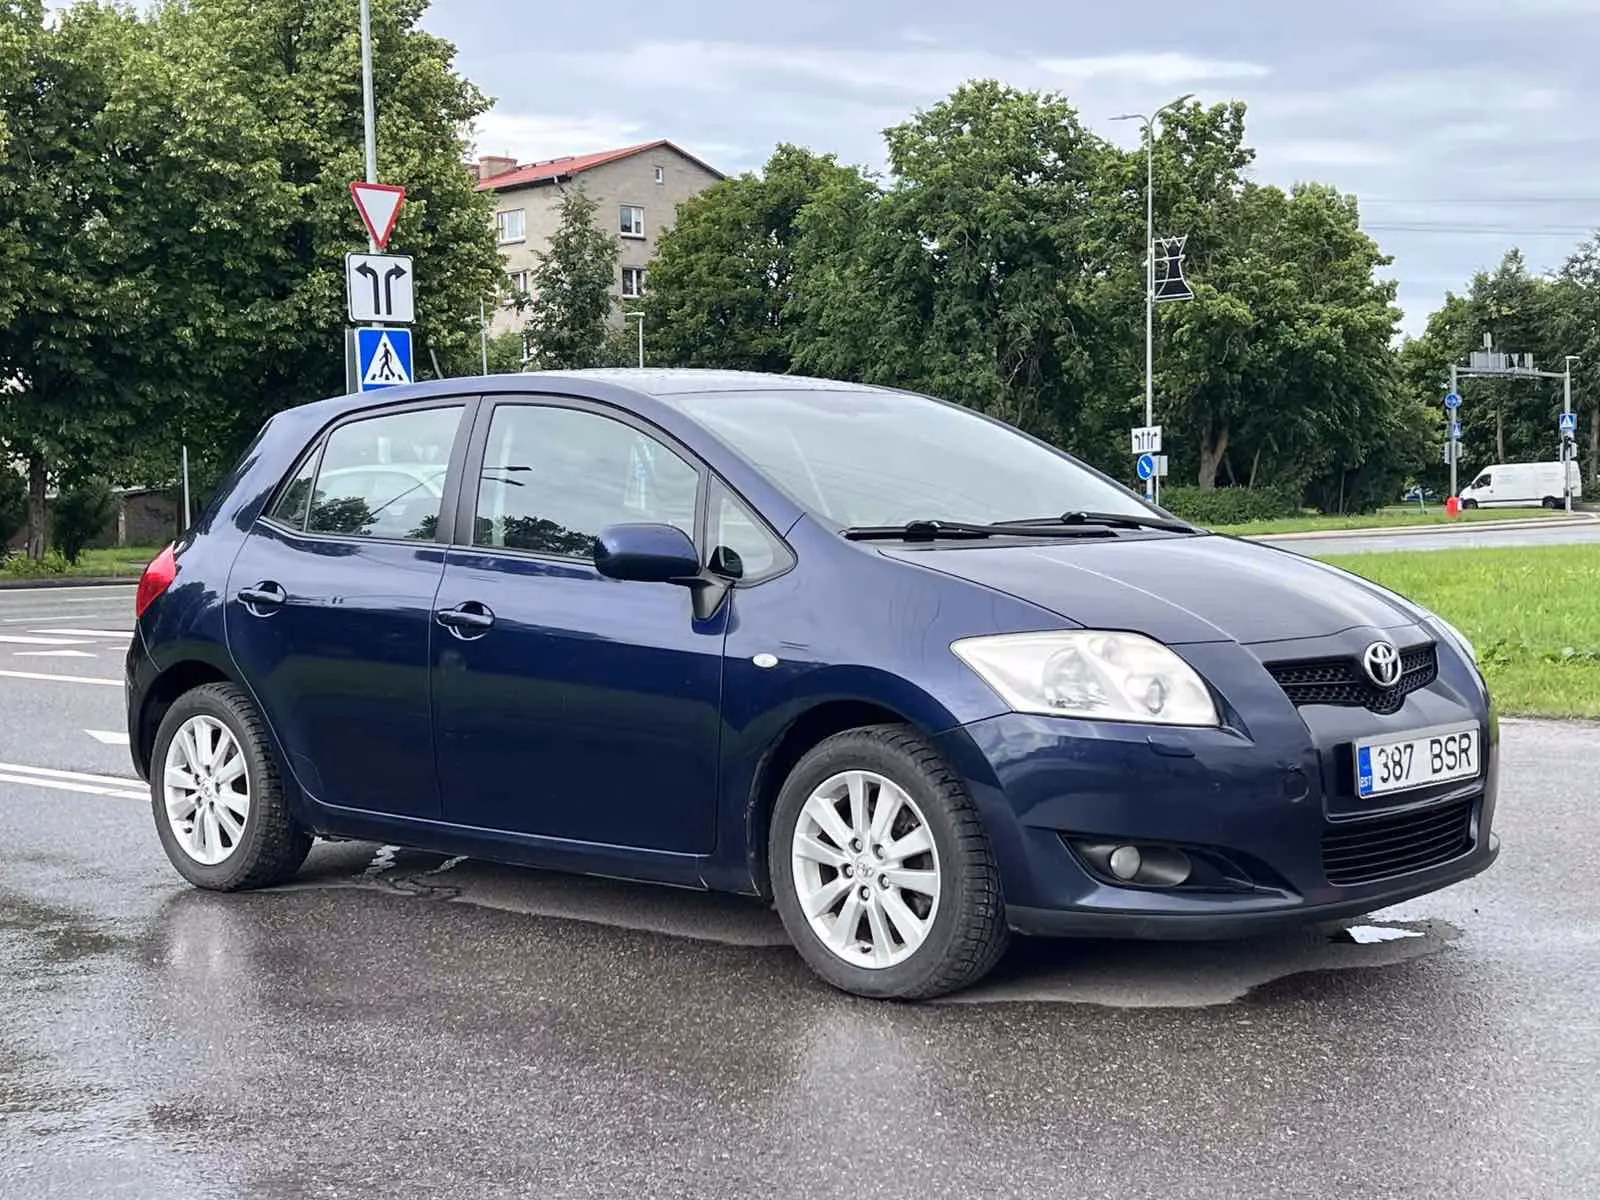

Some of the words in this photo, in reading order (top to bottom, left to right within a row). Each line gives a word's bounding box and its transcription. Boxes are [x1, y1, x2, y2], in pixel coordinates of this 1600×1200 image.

[1378, 744, 1414, 783] 387
[1430, 733, 1471, 774] BSR
[1360, 776, 1372, 787] EST
